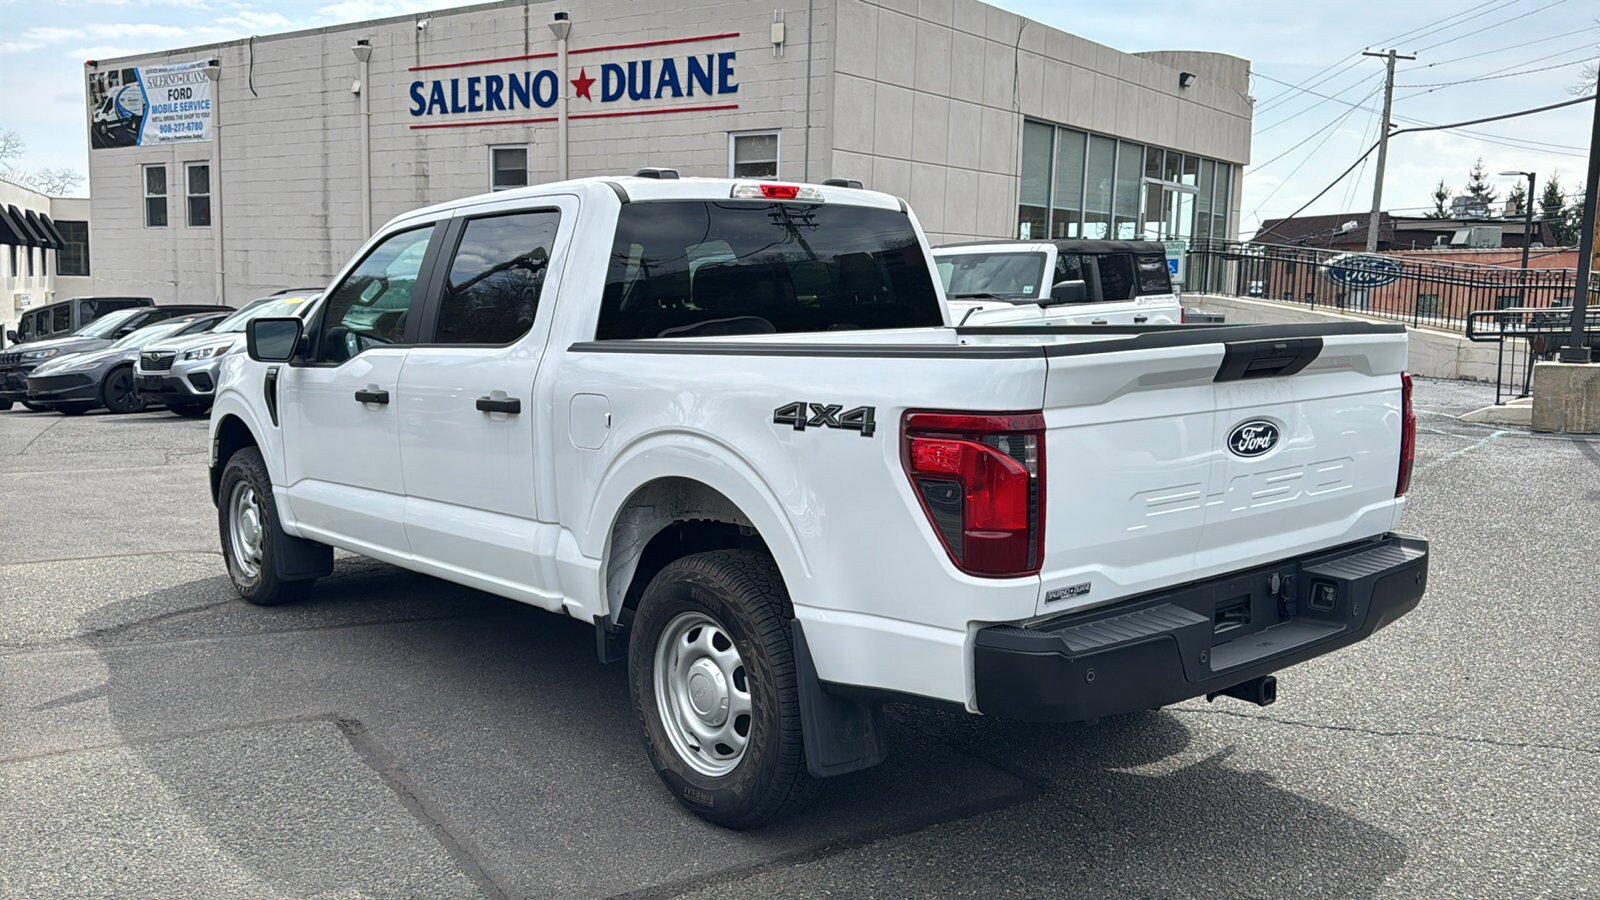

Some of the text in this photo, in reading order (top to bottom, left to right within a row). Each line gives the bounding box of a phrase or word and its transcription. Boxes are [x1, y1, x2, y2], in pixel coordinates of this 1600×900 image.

[409, 51, 740, 117] SALERNO DUANE
[168, 88, 192, 101] FORD
[152, 100, 210, 114] MOBILE SERVICE
[159, 121, 203, 133] 908-277-6780
[1238, 426, 1272, 451] Ford
